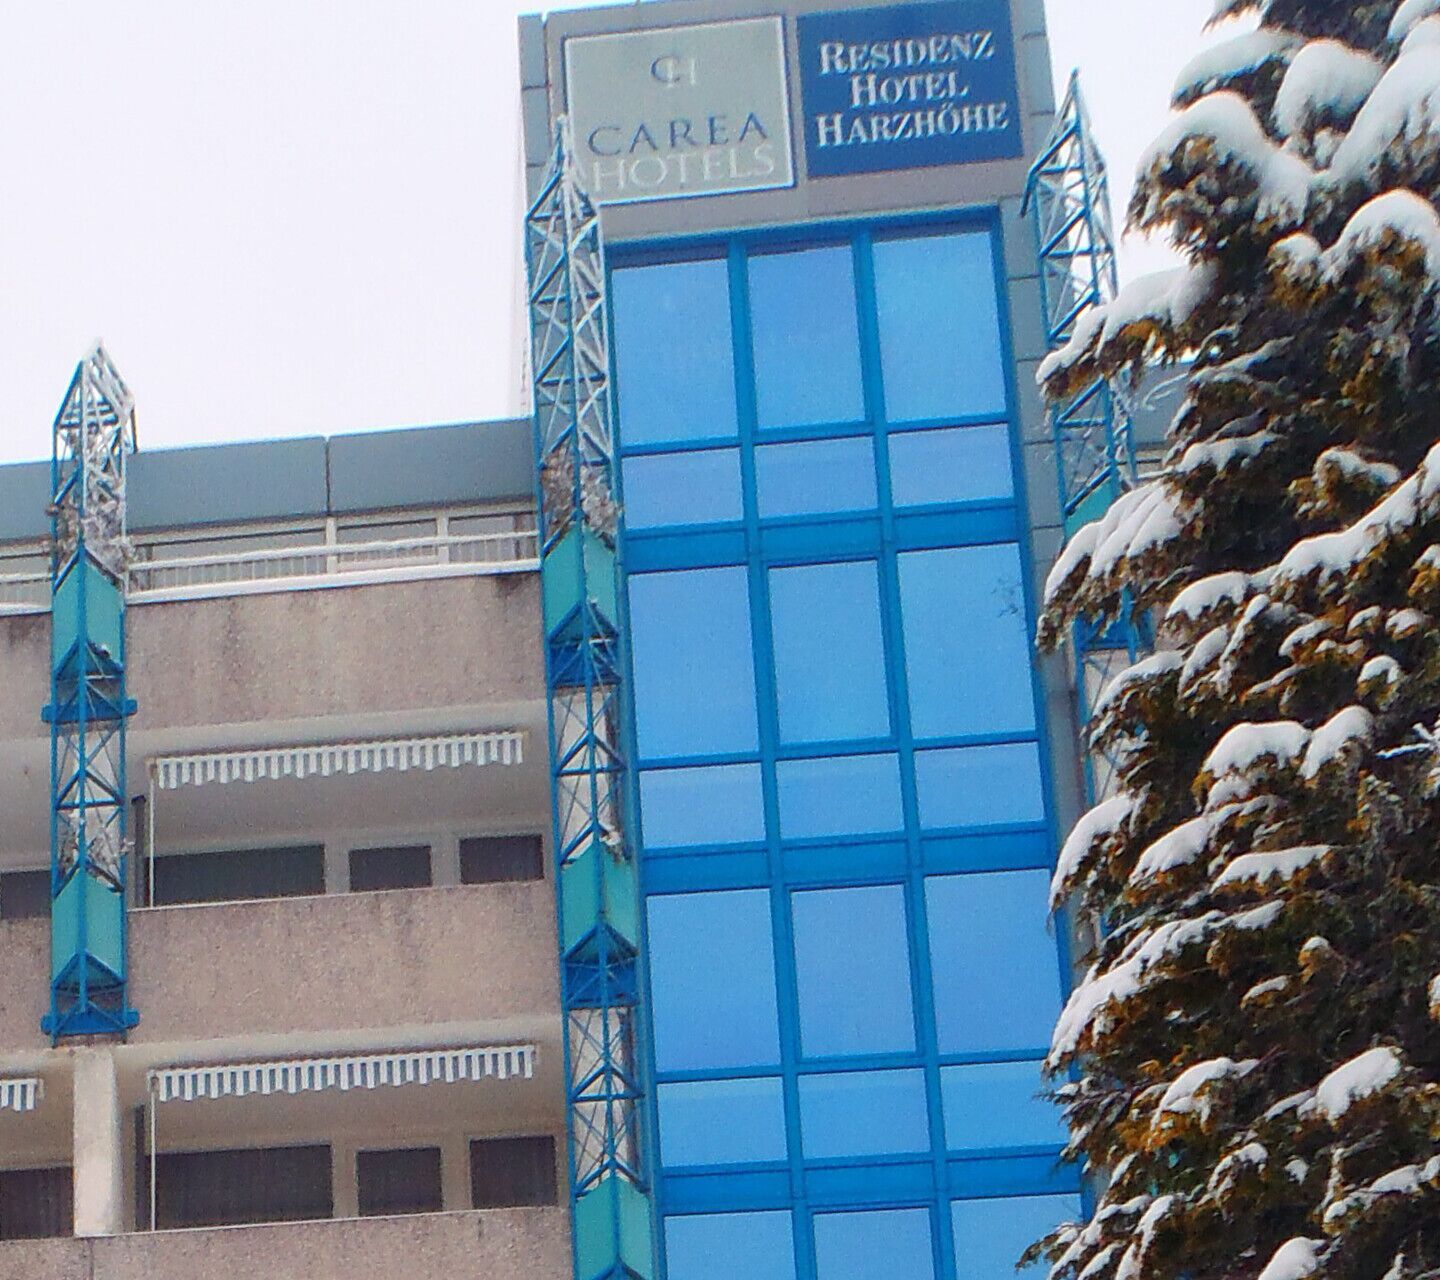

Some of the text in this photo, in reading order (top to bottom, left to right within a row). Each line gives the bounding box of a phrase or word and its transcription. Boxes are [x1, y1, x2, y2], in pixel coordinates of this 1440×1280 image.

[817, 30, 996, 76] RESIDENZ
[850, 70, 970, 108] HOTEL
[588, 112, 768, 156] CAREA
[815, 100, 1009, 149] HARZHÖHE
[593, 143, 775, 192] HOTELS
